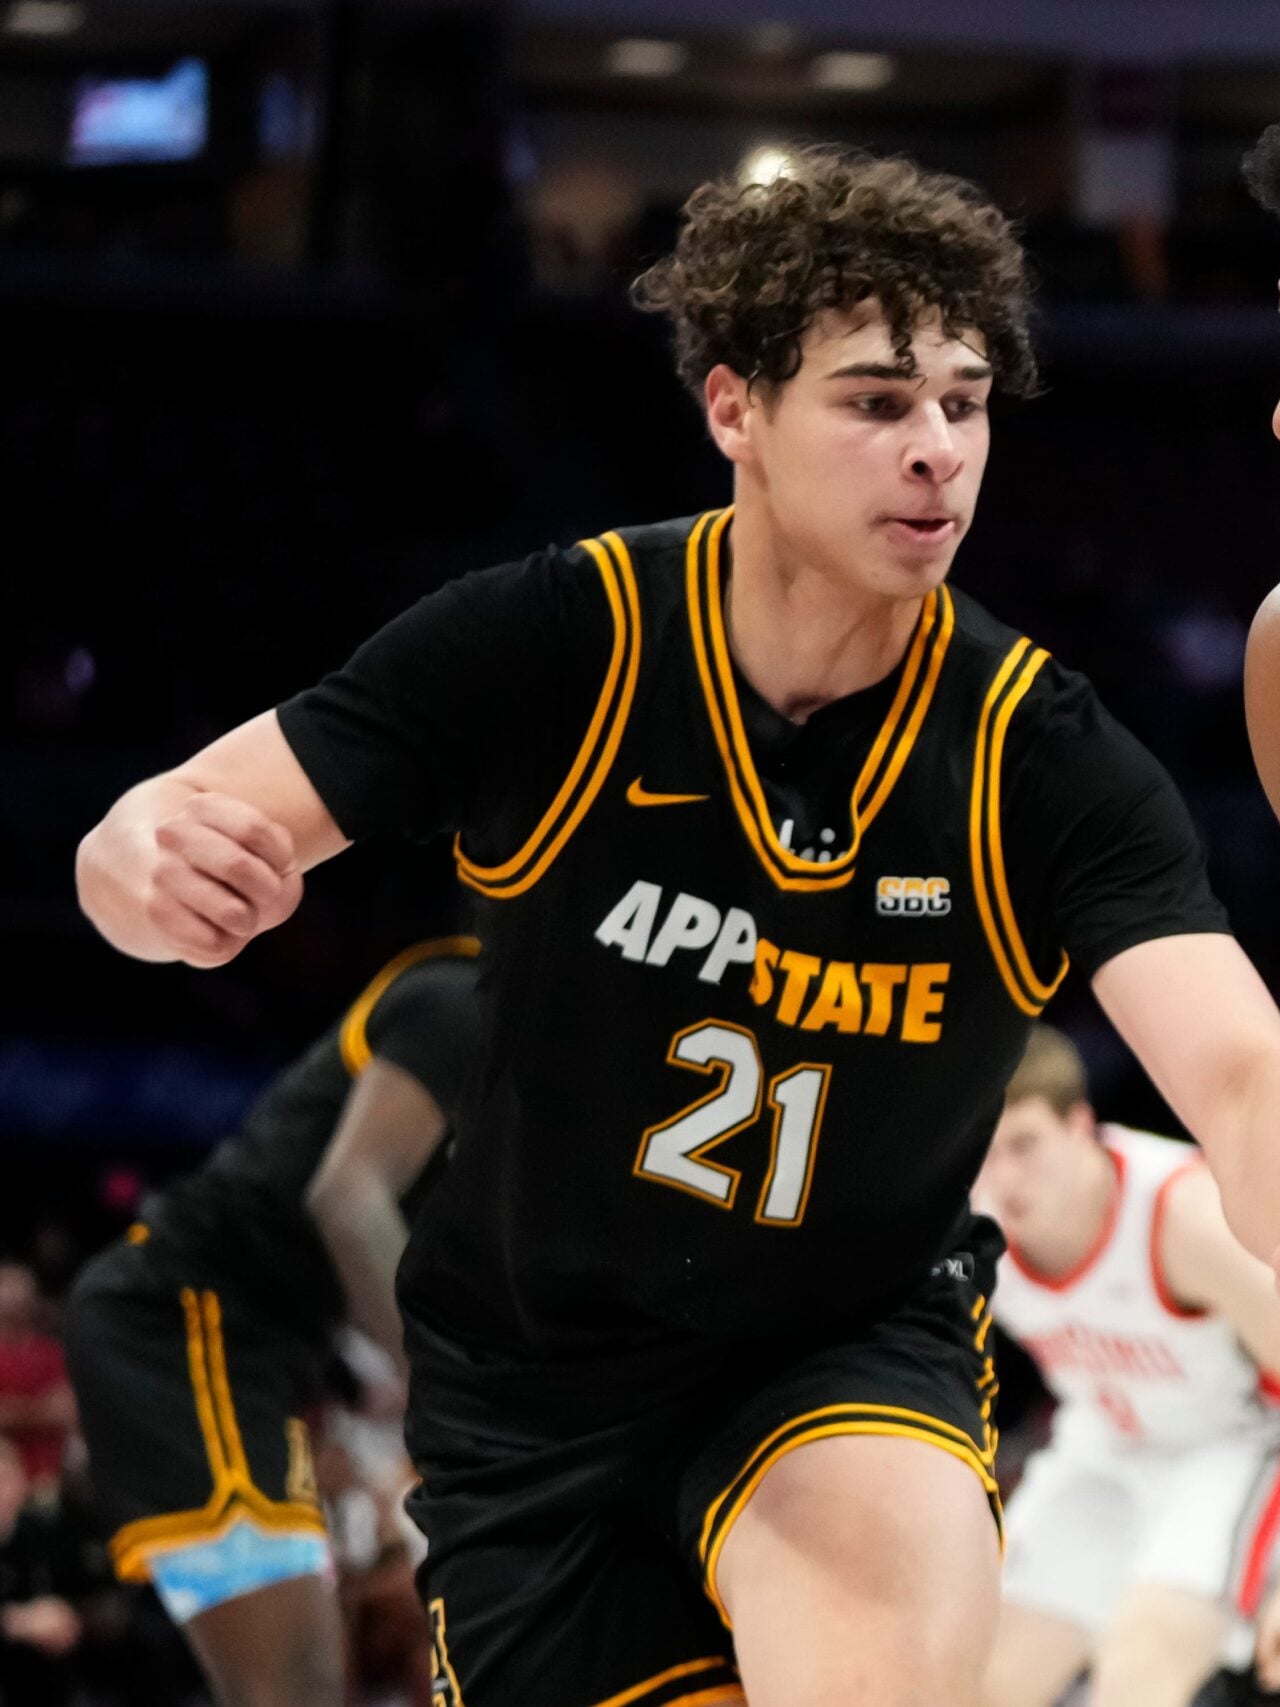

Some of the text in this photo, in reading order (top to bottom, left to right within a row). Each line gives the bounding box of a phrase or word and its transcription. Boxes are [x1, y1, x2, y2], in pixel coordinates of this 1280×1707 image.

[877, 877, 951, 916] SBC
[595, 880, 950, 1043] APP STATE
[633, 1017, 832, 1226] 21
[943, 1258, 969, 1281] XL
